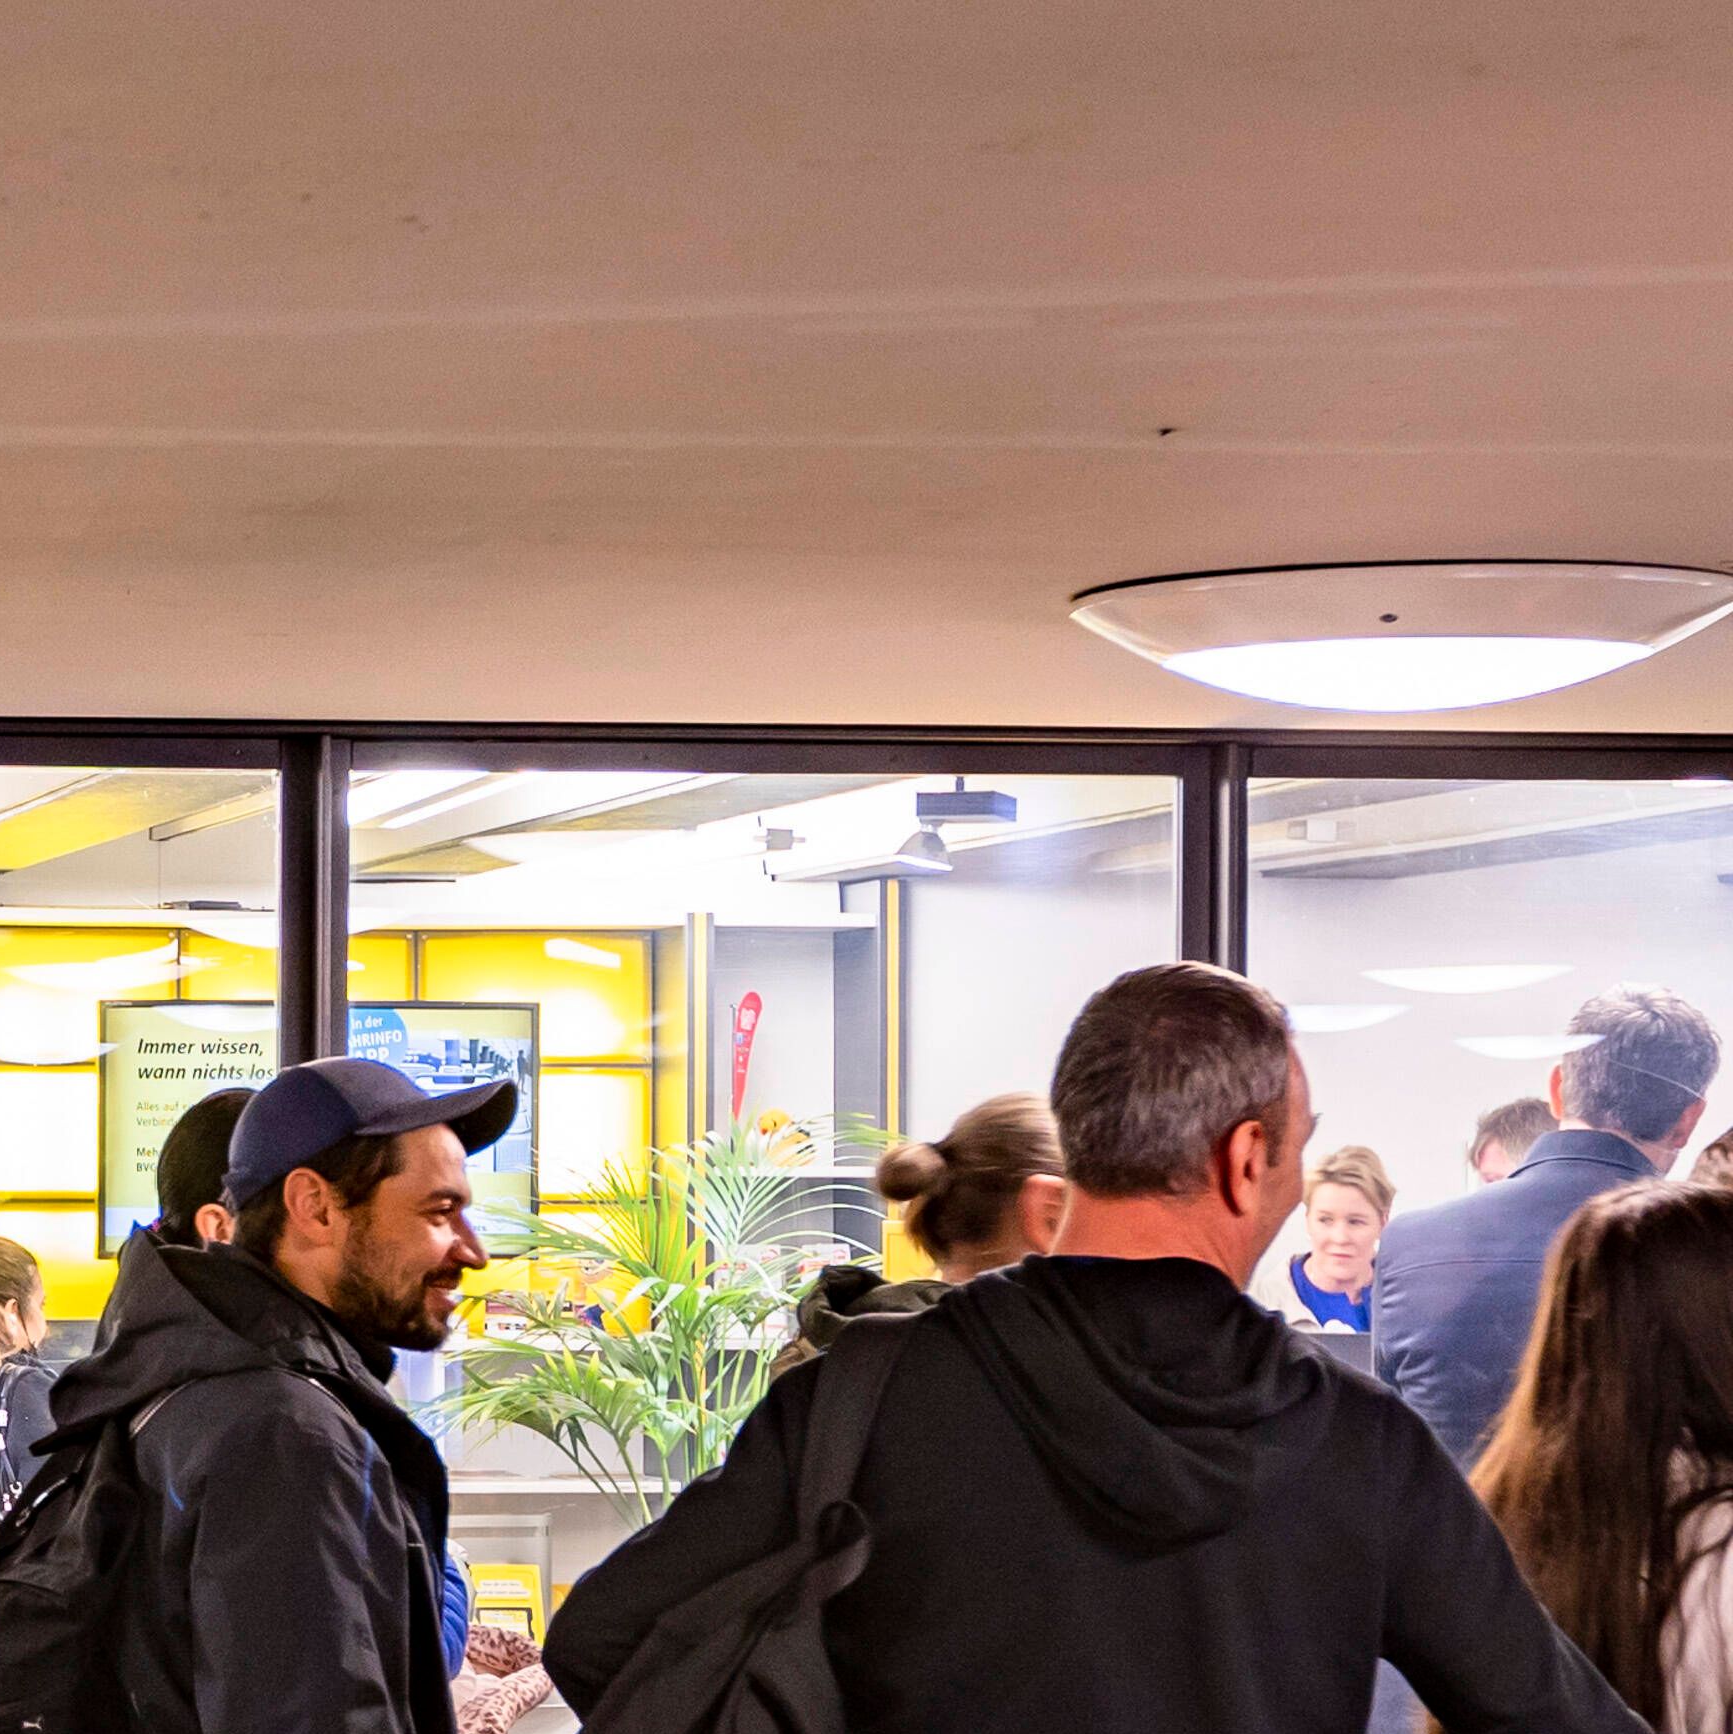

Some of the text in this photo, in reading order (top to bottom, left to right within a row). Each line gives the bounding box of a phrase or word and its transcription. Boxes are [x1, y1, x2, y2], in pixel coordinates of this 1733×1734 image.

[365, 1016, 384, 1028] der
[136, 1038, 264, 1057] Immer wissen,
[137, 1065, 186, 1080] wann
[193, 1063, 244, 1080] nichts
